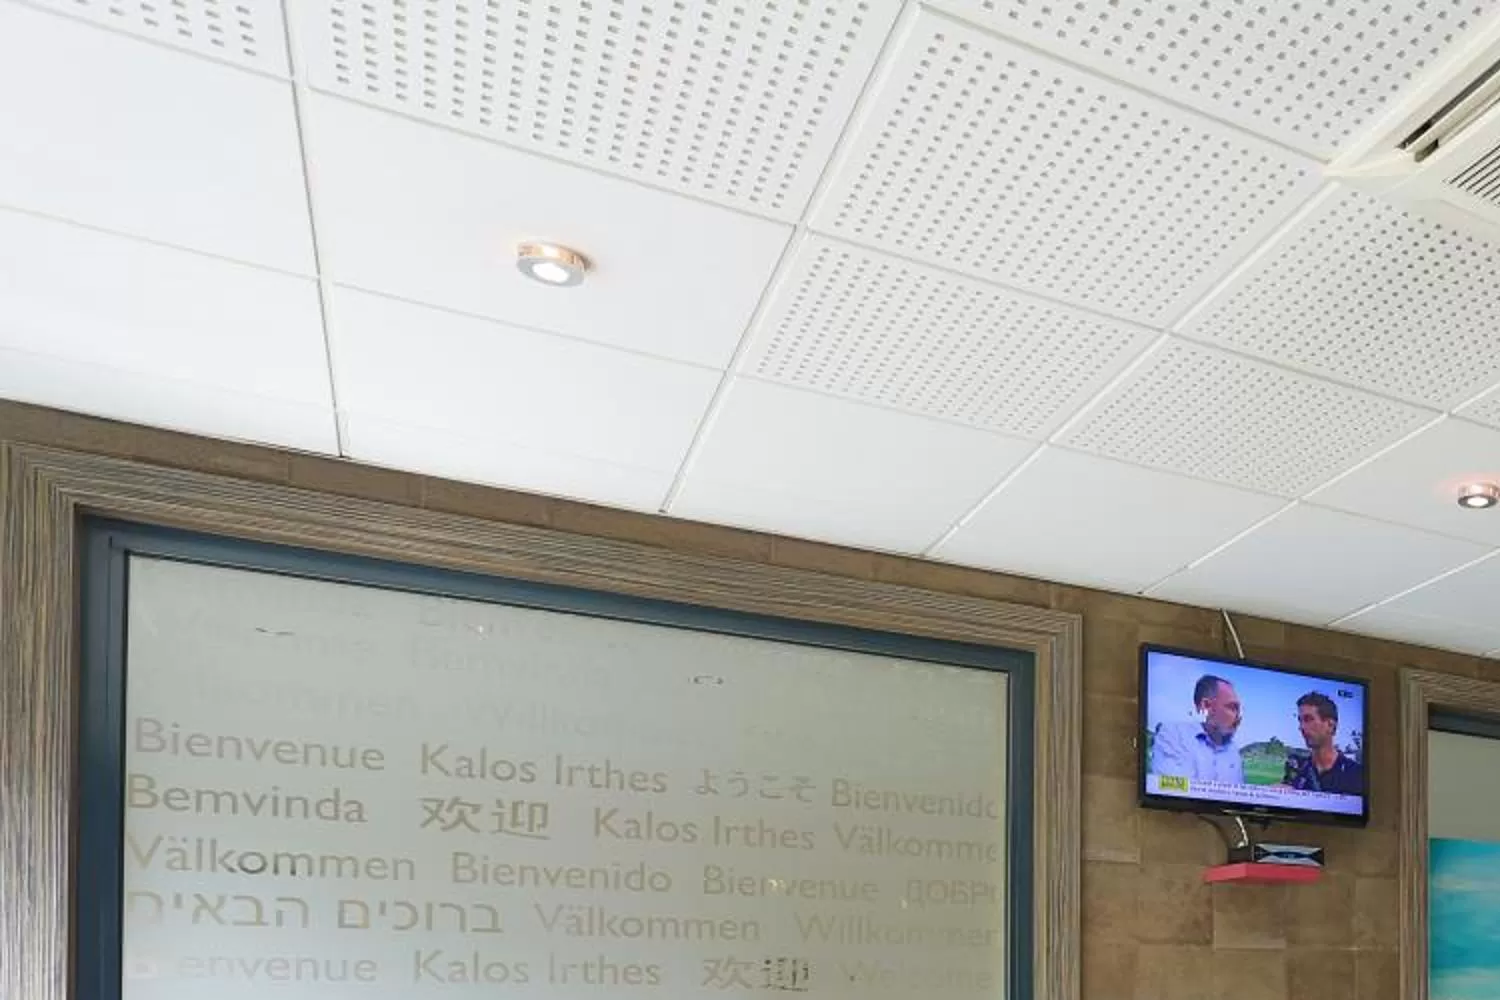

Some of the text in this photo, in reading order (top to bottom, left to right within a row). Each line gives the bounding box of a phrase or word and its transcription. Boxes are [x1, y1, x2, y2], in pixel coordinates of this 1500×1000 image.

[135, 716, 668, 794] Bienvenue Kalos Irthes
[127, 773, 368, 823] Bemvinda
[694, 768, 817, 801] ようこそ
[418, 796, 551, 841] 欢迎
[593, 807, 698, 844] Kalos
[712, 815, 816, 851] Irthes
[125, 834, 879, 899] Välkommen Bienvenido Bienvenue
[336, 898, 504, 933] ברוכים
[533, 901, 760, 942] Välkommen
[414, 949, 529, 986] Kalos
[548, 952, 662, 987] Irthes
[701, 956, 812, 992] 欢迎
